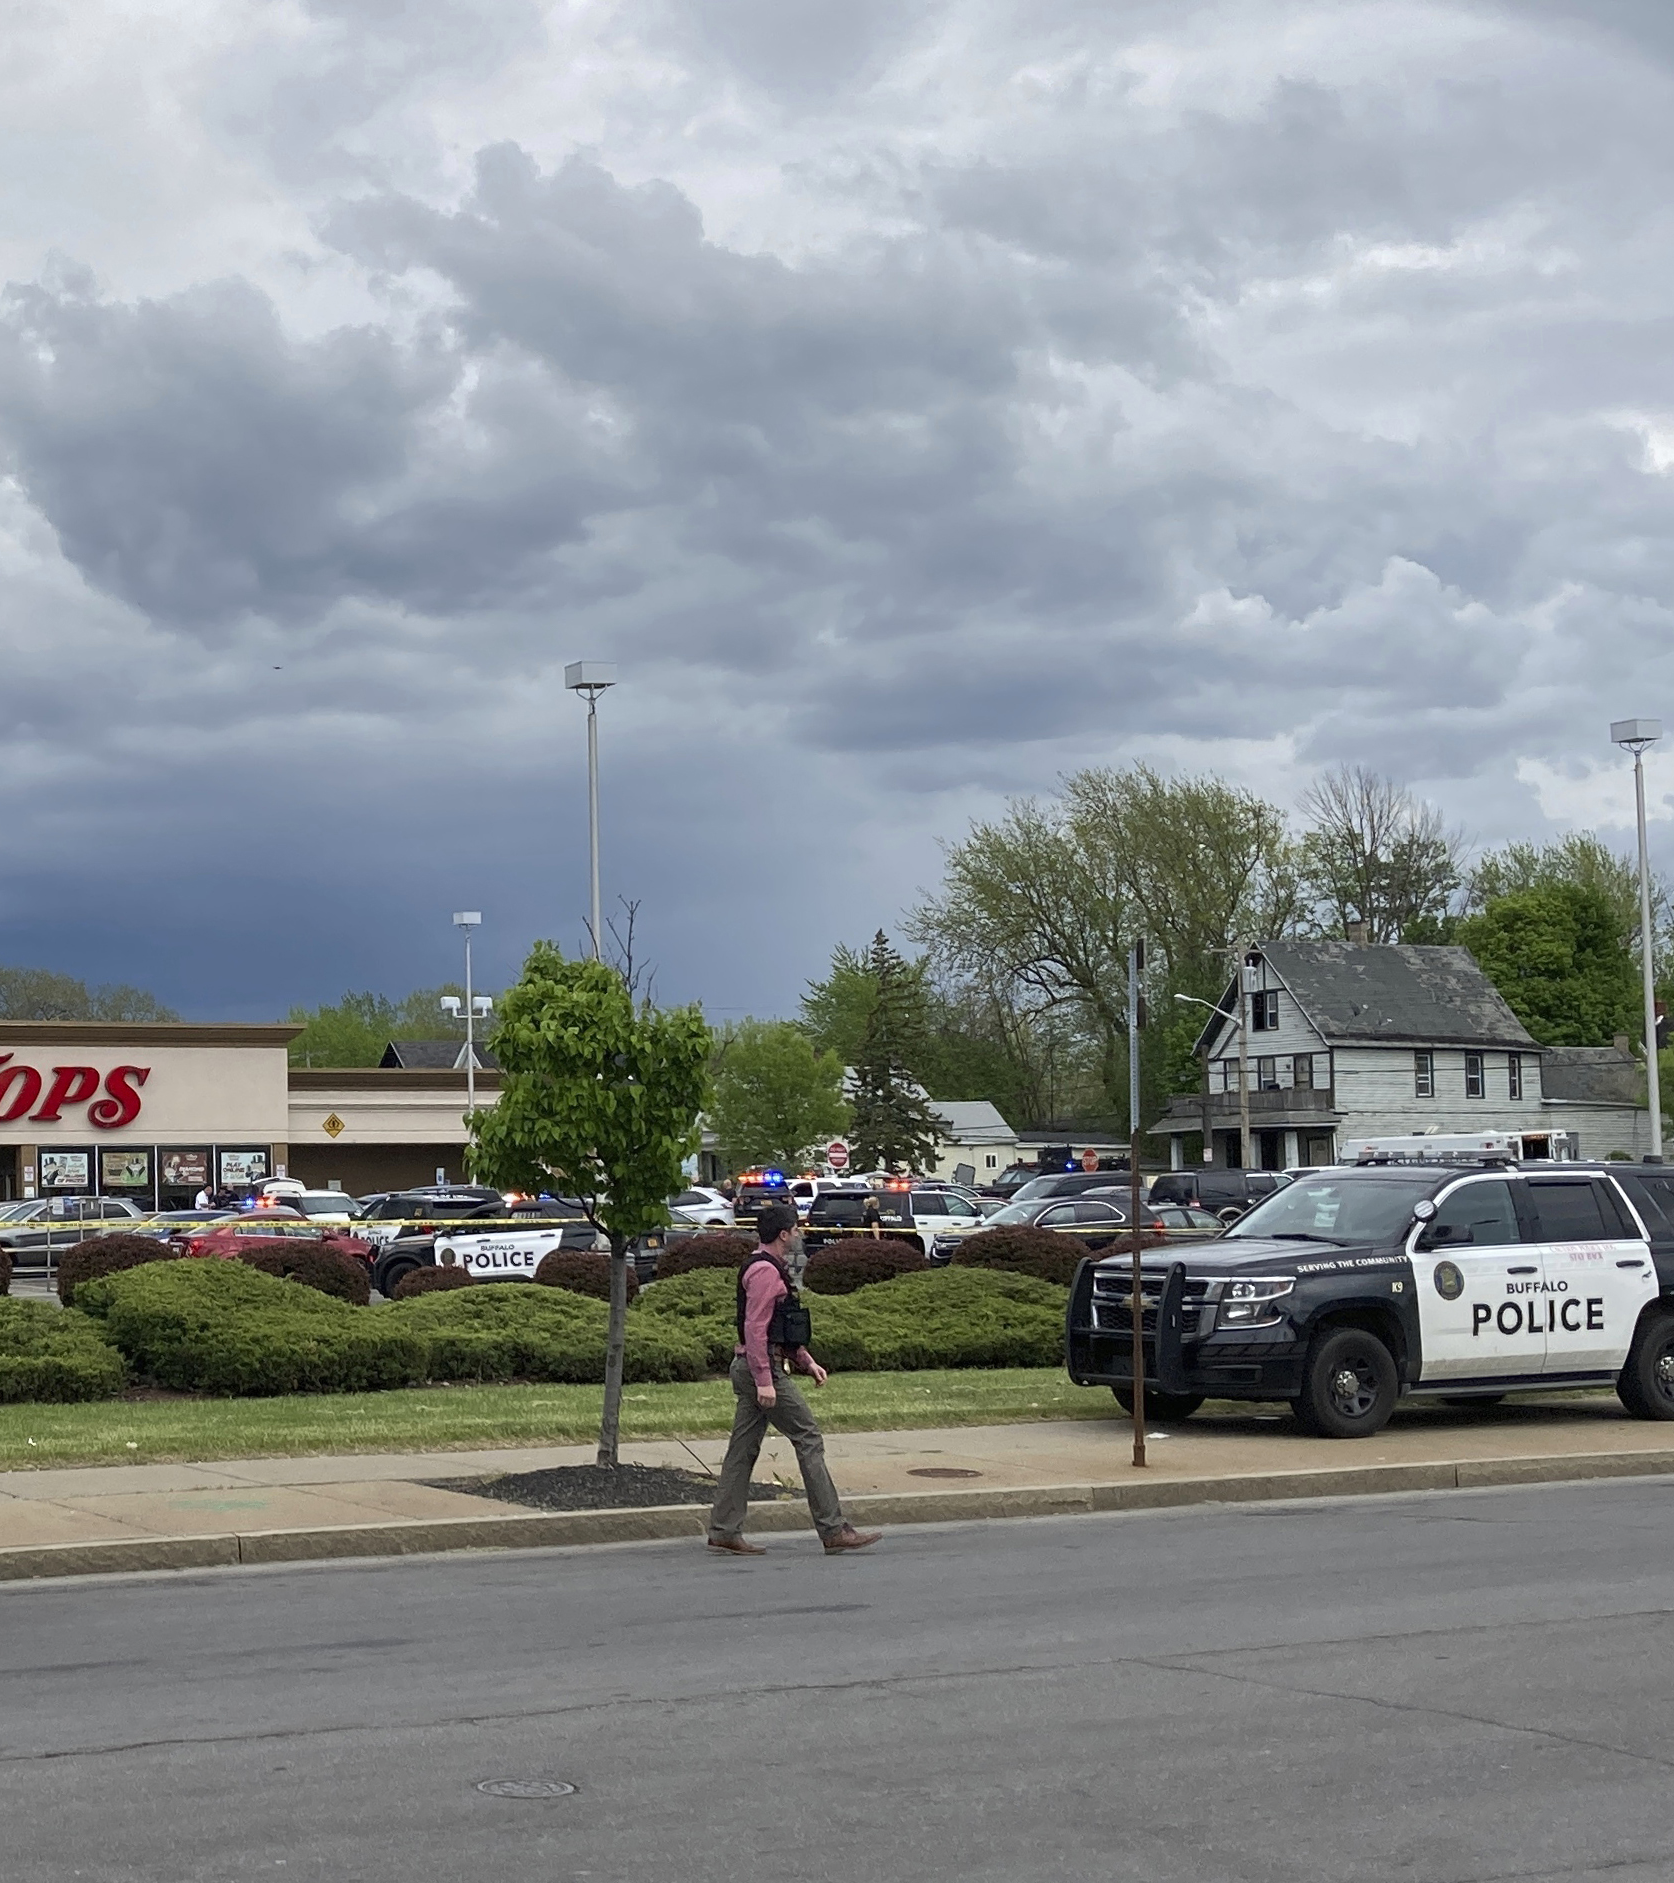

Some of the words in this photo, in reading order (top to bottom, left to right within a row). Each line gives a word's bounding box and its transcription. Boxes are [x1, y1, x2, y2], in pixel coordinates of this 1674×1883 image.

[463, 1251, 534, 1268] POLICE
[1297, 1261, 1336, 1273] SERVING
[1339, 1259, 1355, 1269] THE
[1356, 1255, 1407, 1266] COMMUNITY
[1392, 1281, 1404, 1293] K9
[1506, 1280, 1568, 1295] BUFFALO
[1472, 1297, 1605, 1337] POLICE
